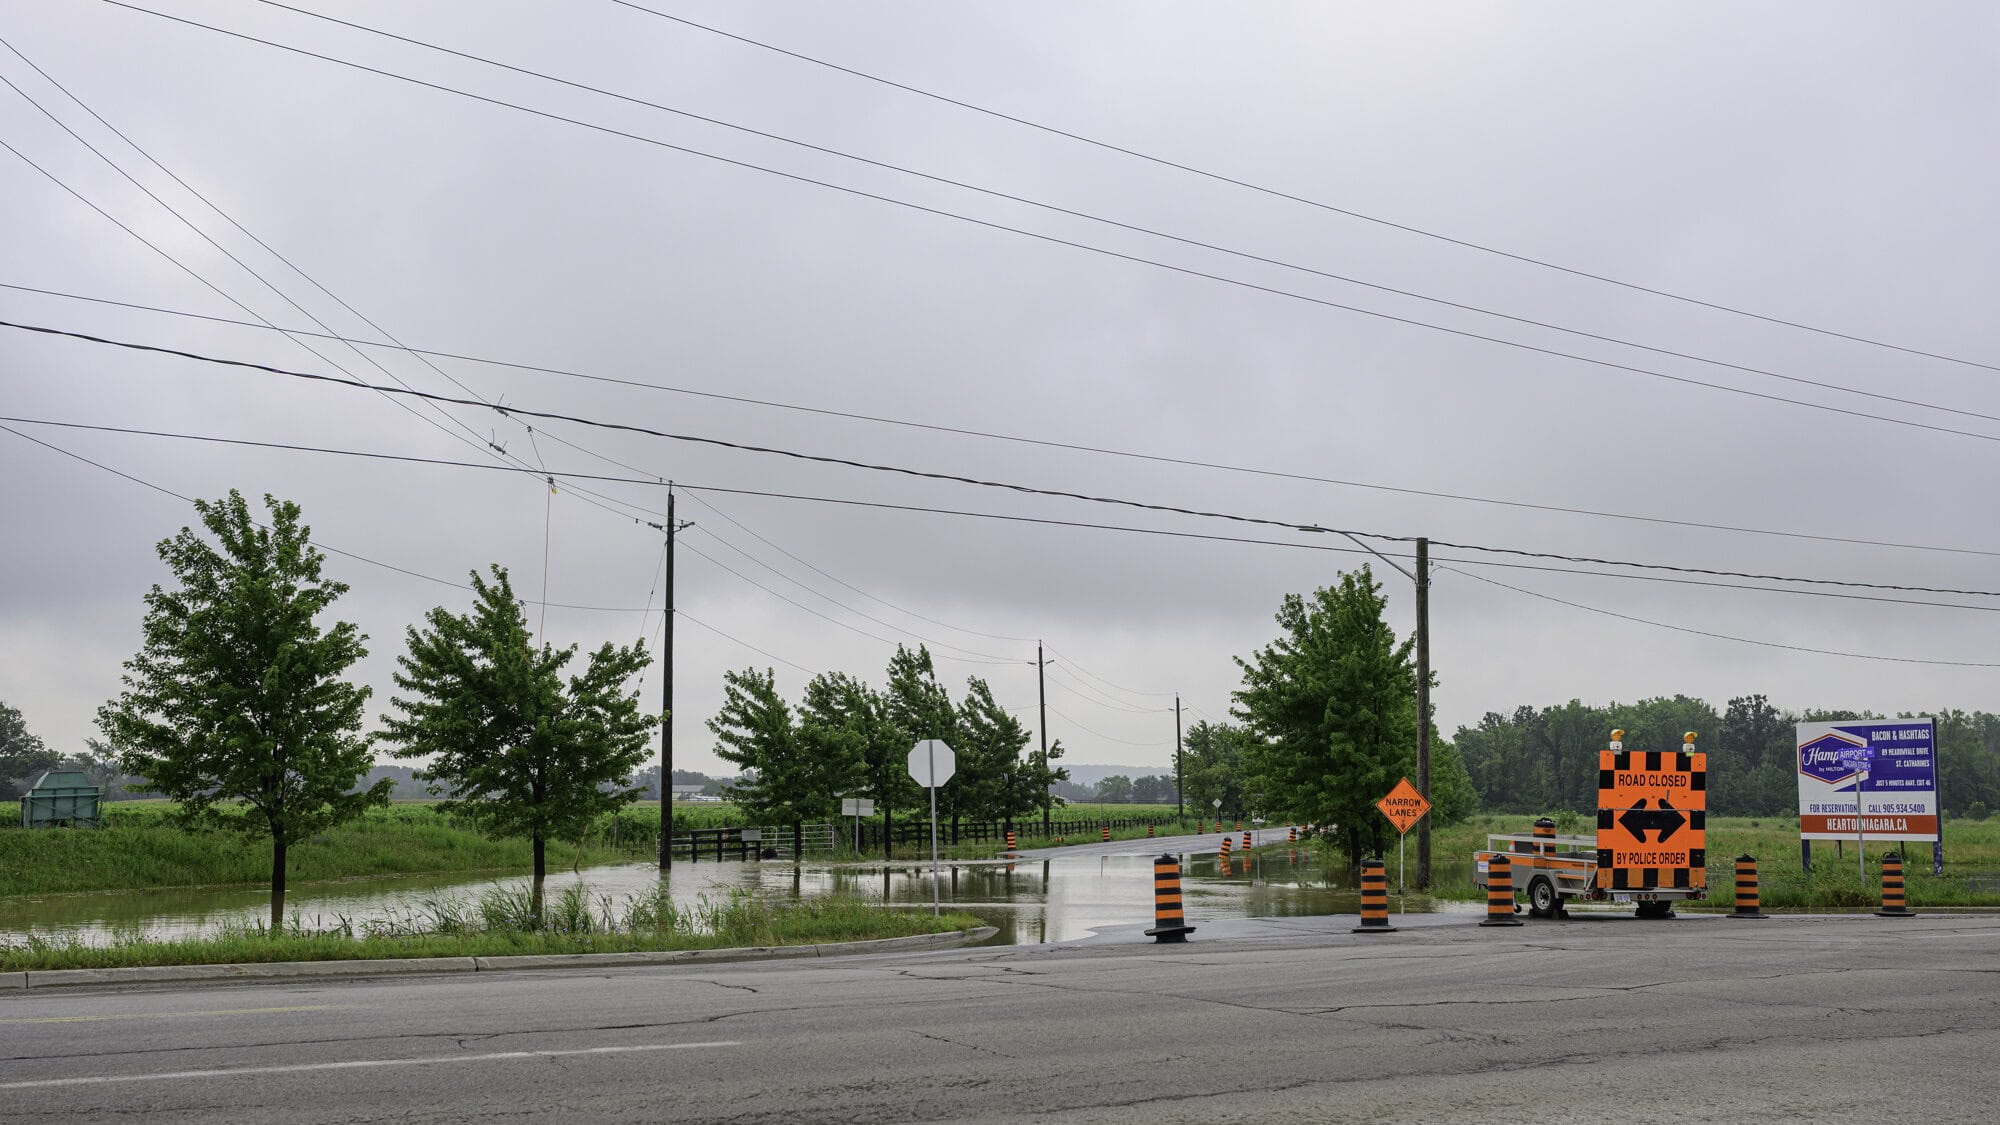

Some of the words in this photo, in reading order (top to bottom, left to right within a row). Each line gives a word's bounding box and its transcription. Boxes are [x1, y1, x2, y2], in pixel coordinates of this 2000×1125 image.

[1872, 731, 1891, 741] BACON
[1892, 730, 1897, 740] &
[1898, 730, 1929, 740] HASHTAGS
[1802, 746, 1839, 766] Hamp
[1839, 749, 1866, 758] AIRPORT
[1619, 774, 1645, 786] ROAD
[1649, 774, 1686, 787] CLOSED
[1390, 809, 1416, 817] LANES
[1810, 804, 1820, 813] FOR
[1821, 804, 1858, 813] RESERVATION
[1868, 804, 1882, 813] CALL
[1883, 804, 1925, 813] 905.934.5400
[1827, 818, 1907, 831] HEARTONIAGARA.CA
[1617, 853, 1626, 864] BY
[1629, 853, 1656, 864] POLICE
[1659, 853, 1685, 864] ORDER
